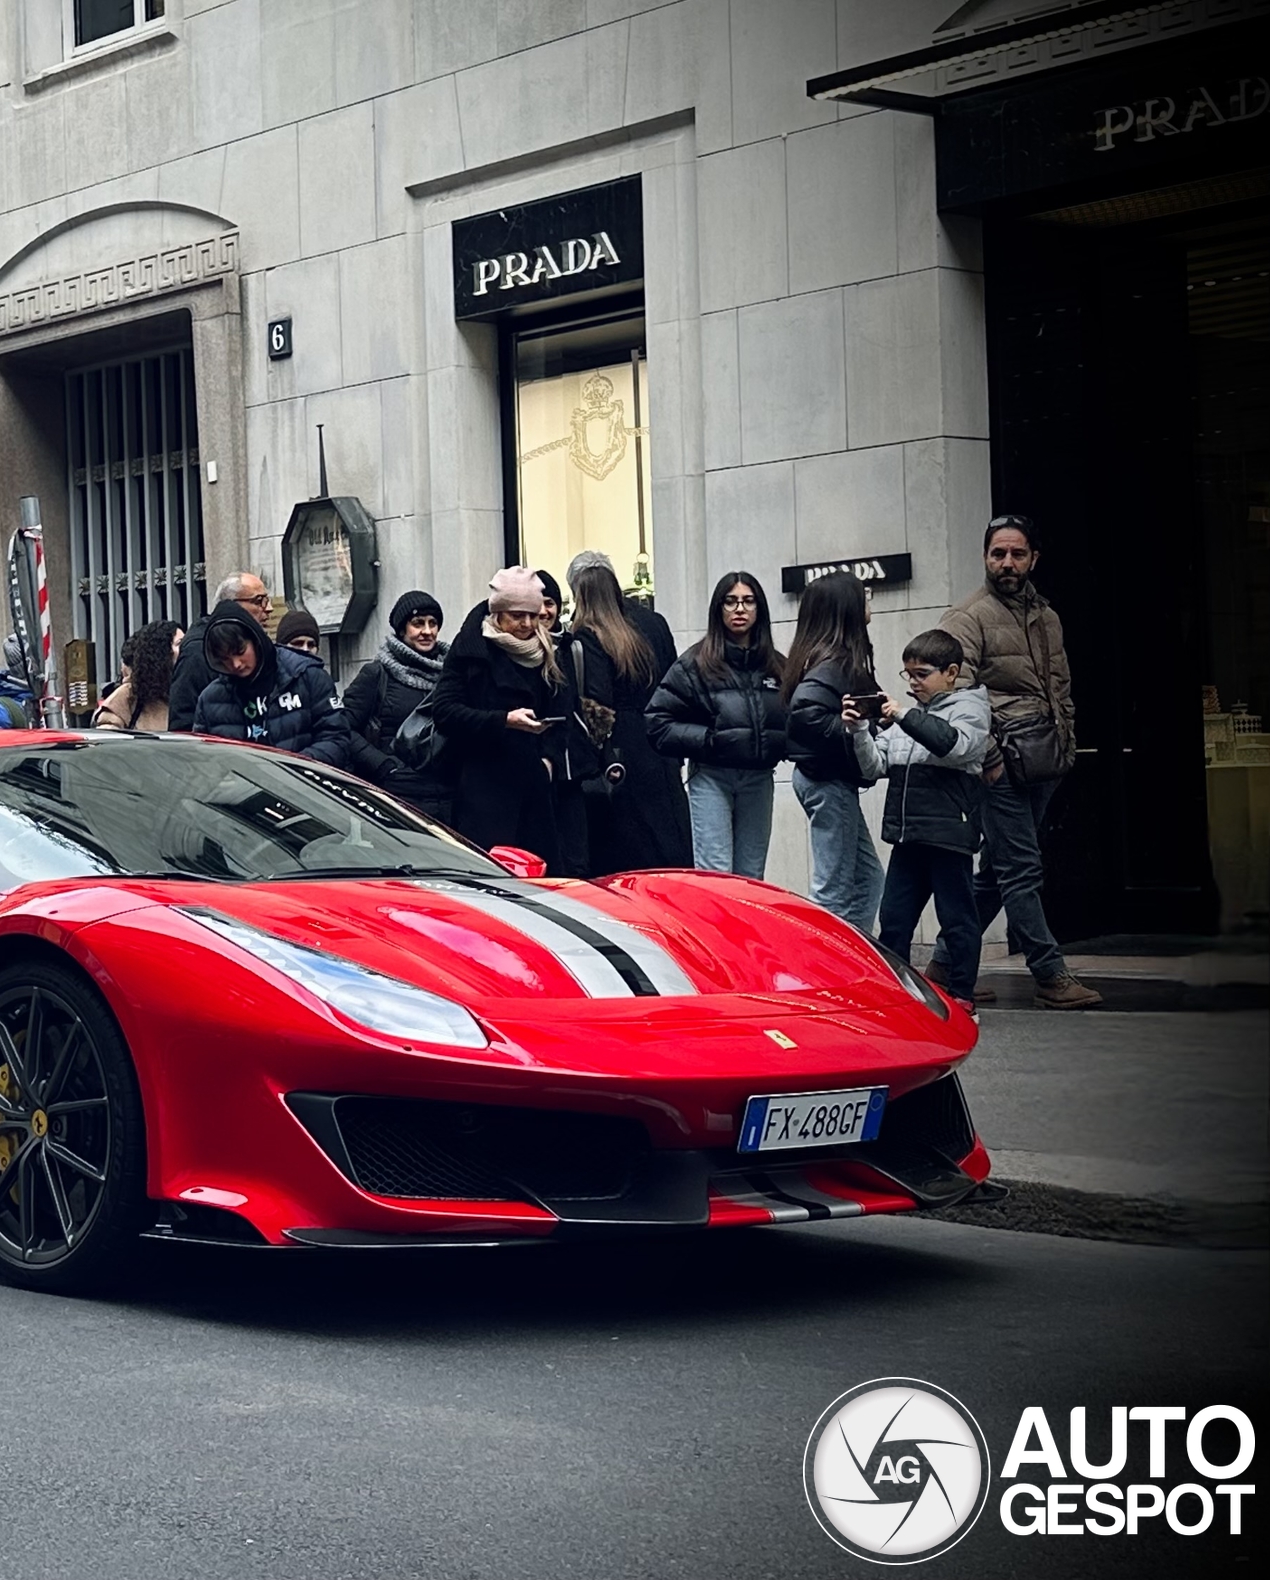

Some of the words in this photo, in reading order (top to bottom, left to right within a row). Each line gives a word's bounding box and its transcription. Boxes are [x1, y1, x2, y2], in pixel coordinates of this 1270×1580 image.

[471, 231, 622, 296] PRADA
[272, 324, 284, 351] 6
[764, 1107, 796, 1142] FX
[798, 1101, 868, 1139] 488GF
